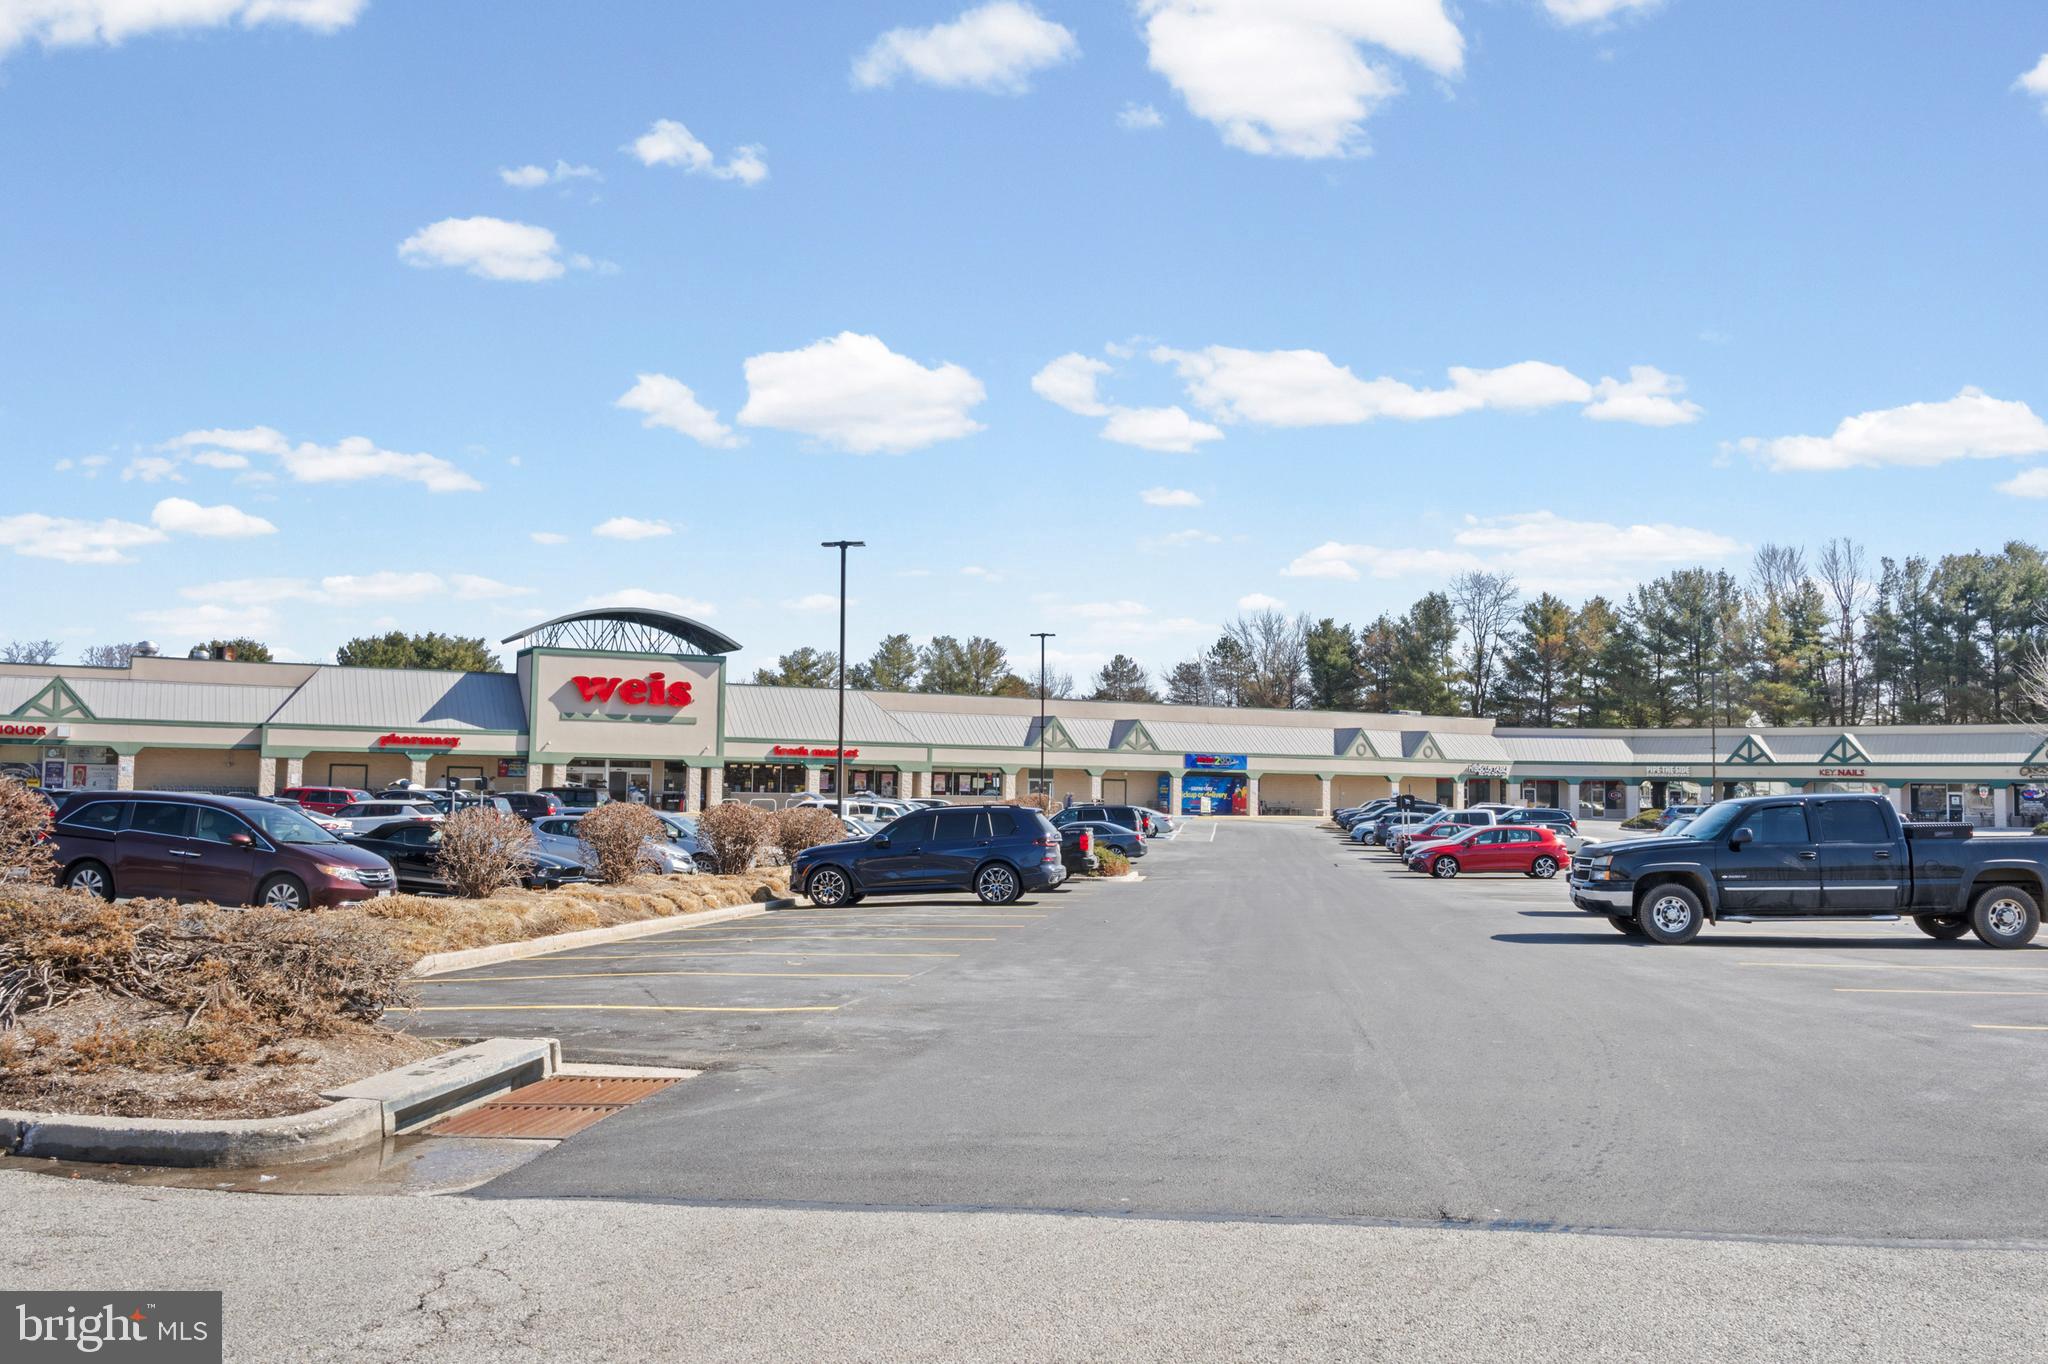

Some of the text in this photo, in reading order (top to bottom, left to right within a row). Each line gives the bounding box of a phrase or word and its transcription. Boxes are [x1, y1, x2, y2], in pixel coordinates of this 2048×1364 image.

[571, 672, 693, 707] weis
[379, 732, 460, 748] pharmacy
[1675, 766, 1690, 774] SIDE
[1819, 769, 1865, 777] KEY NAILS
